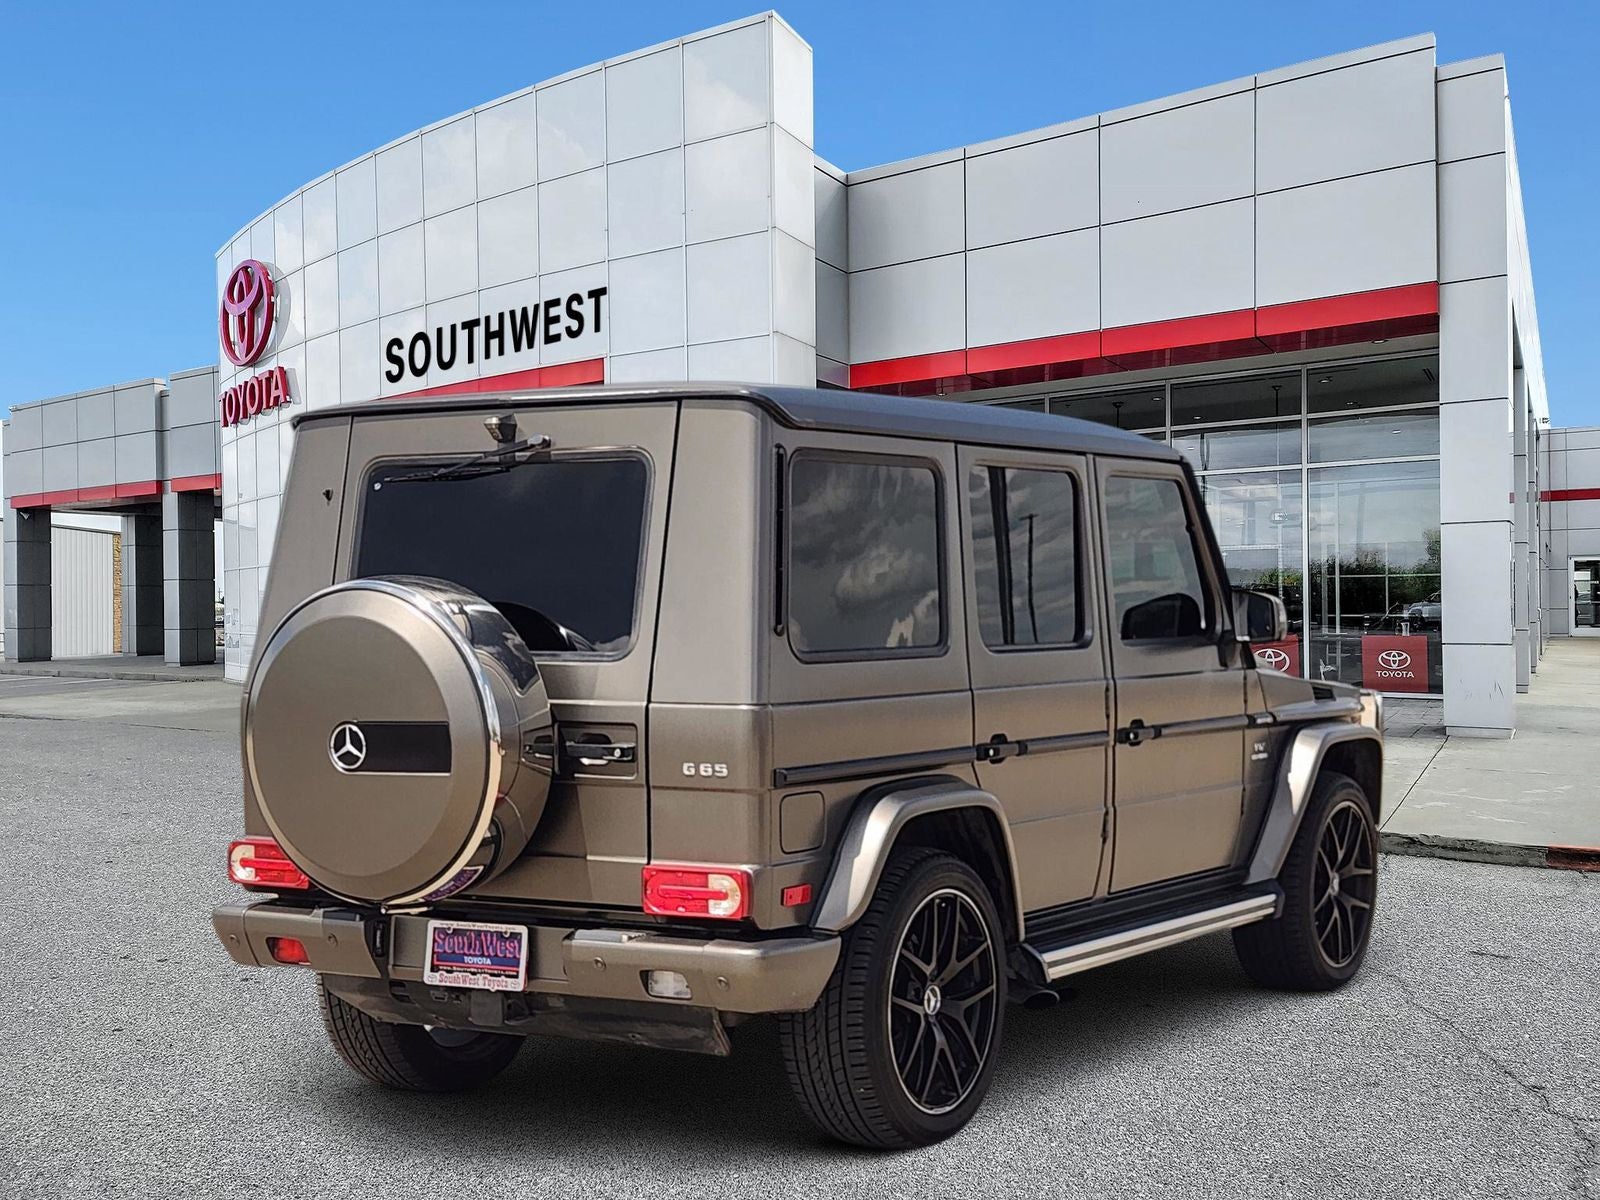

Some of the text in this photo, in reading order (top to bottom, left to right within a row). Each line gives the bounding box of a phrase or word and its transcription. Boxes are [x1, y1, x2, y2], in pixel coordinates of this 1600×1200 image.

[385, 286, 608, 384] SOUTHWEST
[218, 366, 292, 428] TOYOTA
[1376, 670, 1414, 678] TOYOTA
[682, 762, 729, 777] G 65
[434, 928, 521, 958] SouthWest
[464, 956, 491, 964] TOYOTA
[439, 973, 509, 989] SouthWest Toyota
